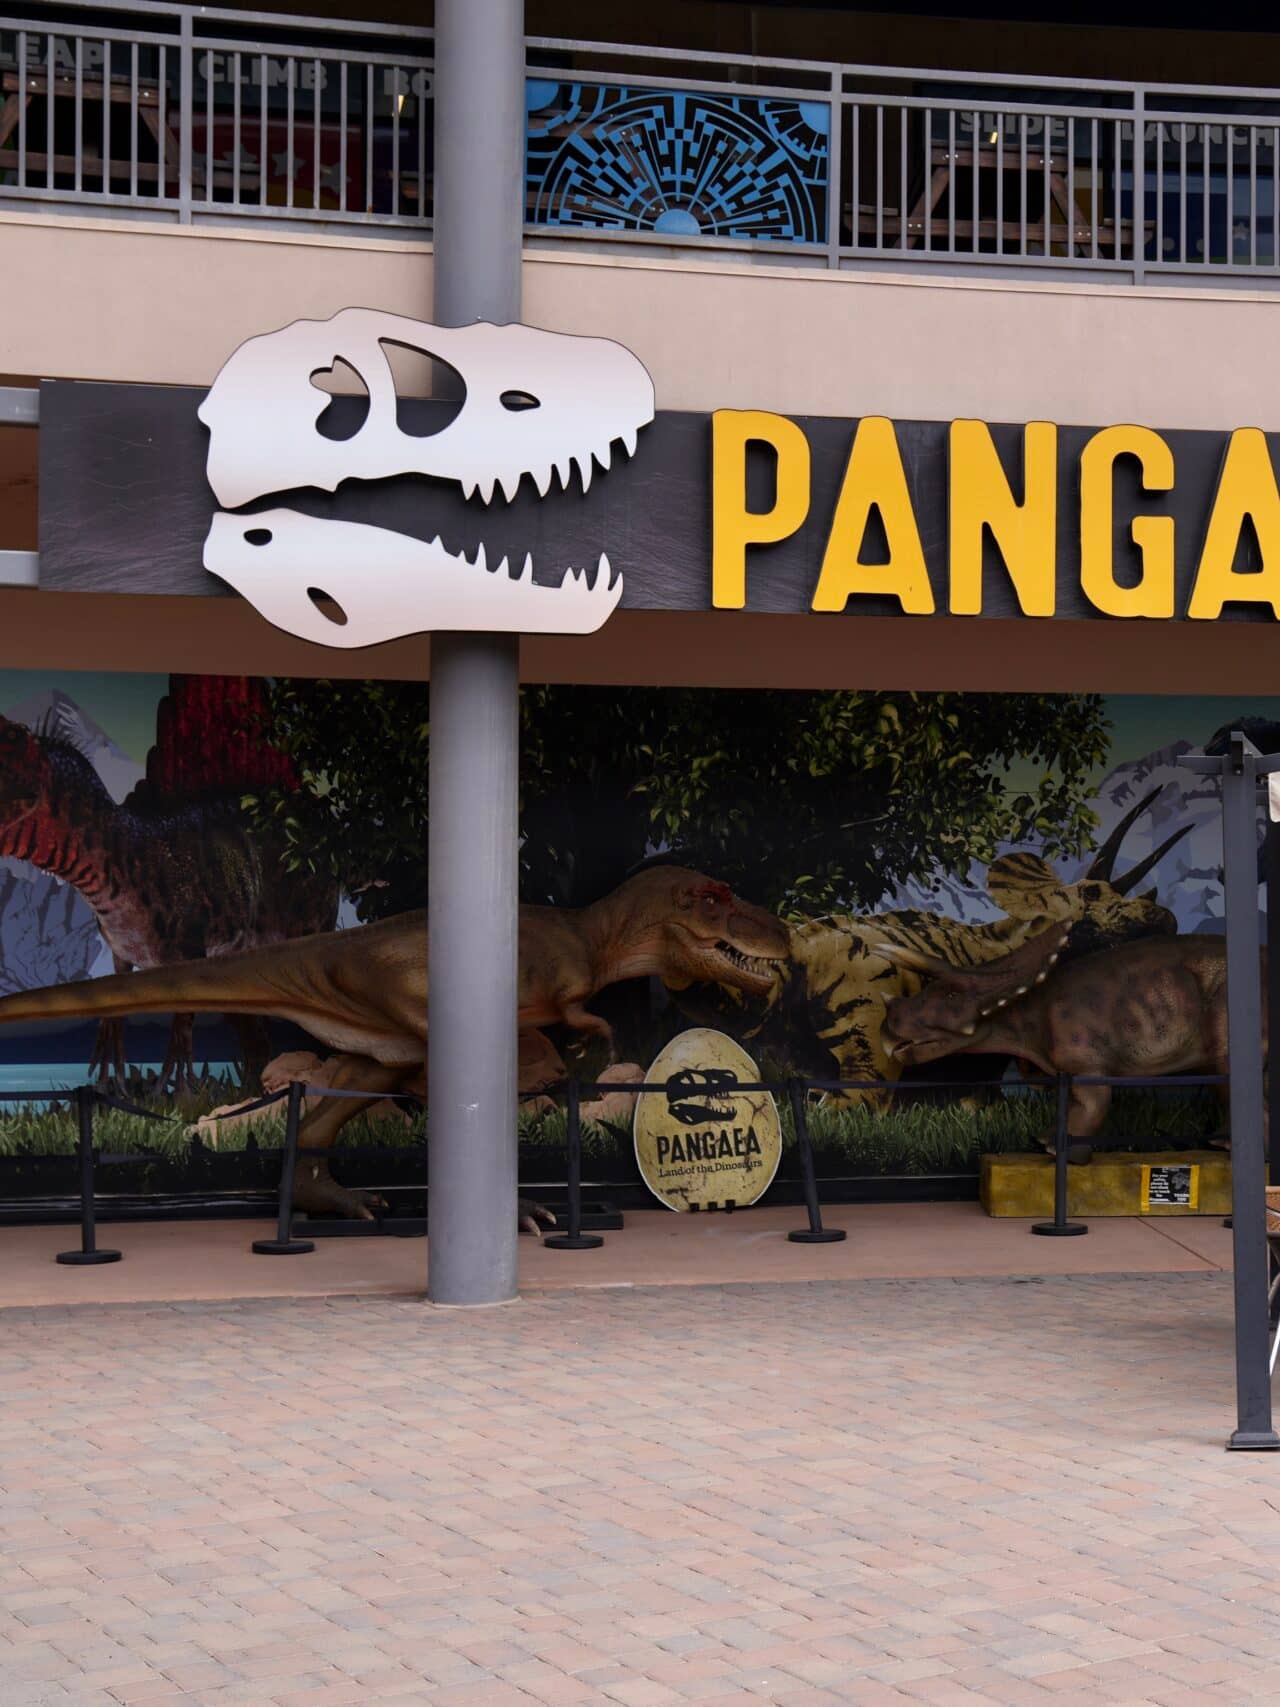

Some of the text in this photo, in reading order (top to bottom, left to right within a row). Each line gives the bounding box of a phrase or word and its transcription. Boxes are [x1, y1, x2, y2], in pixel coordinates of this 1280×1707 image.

[199, 54, 328, 91] CLIMB
[656, 1125, 762, 1165] PANGAEA
[658, 1158, 763, 1178] Land of the Dinosaurs
